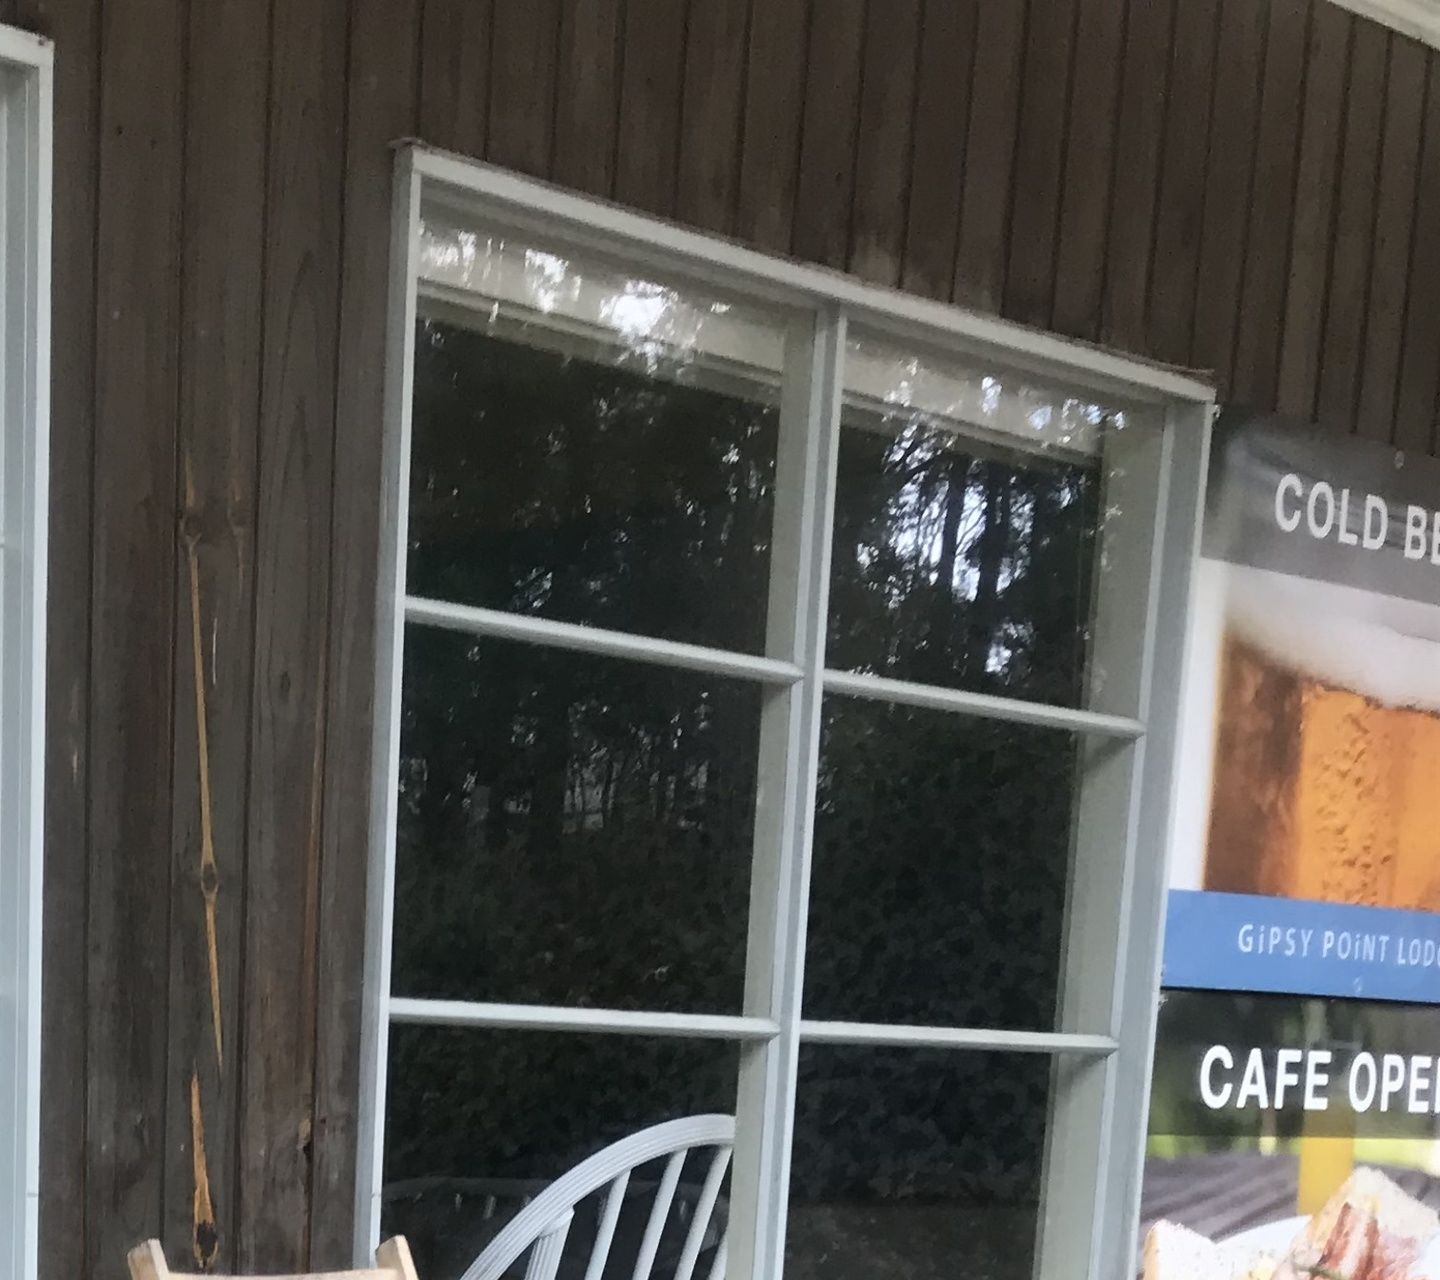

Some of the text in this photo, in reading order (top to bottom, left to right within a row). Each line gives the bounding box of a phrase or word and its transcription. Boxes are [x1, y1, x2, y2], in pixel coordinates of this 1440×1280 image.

[1275, 473, 1388, 550] COLD
[1398, 937, 1440, 967] LOD
[1200, 1045, 1440, 1114] CAFE OPE
